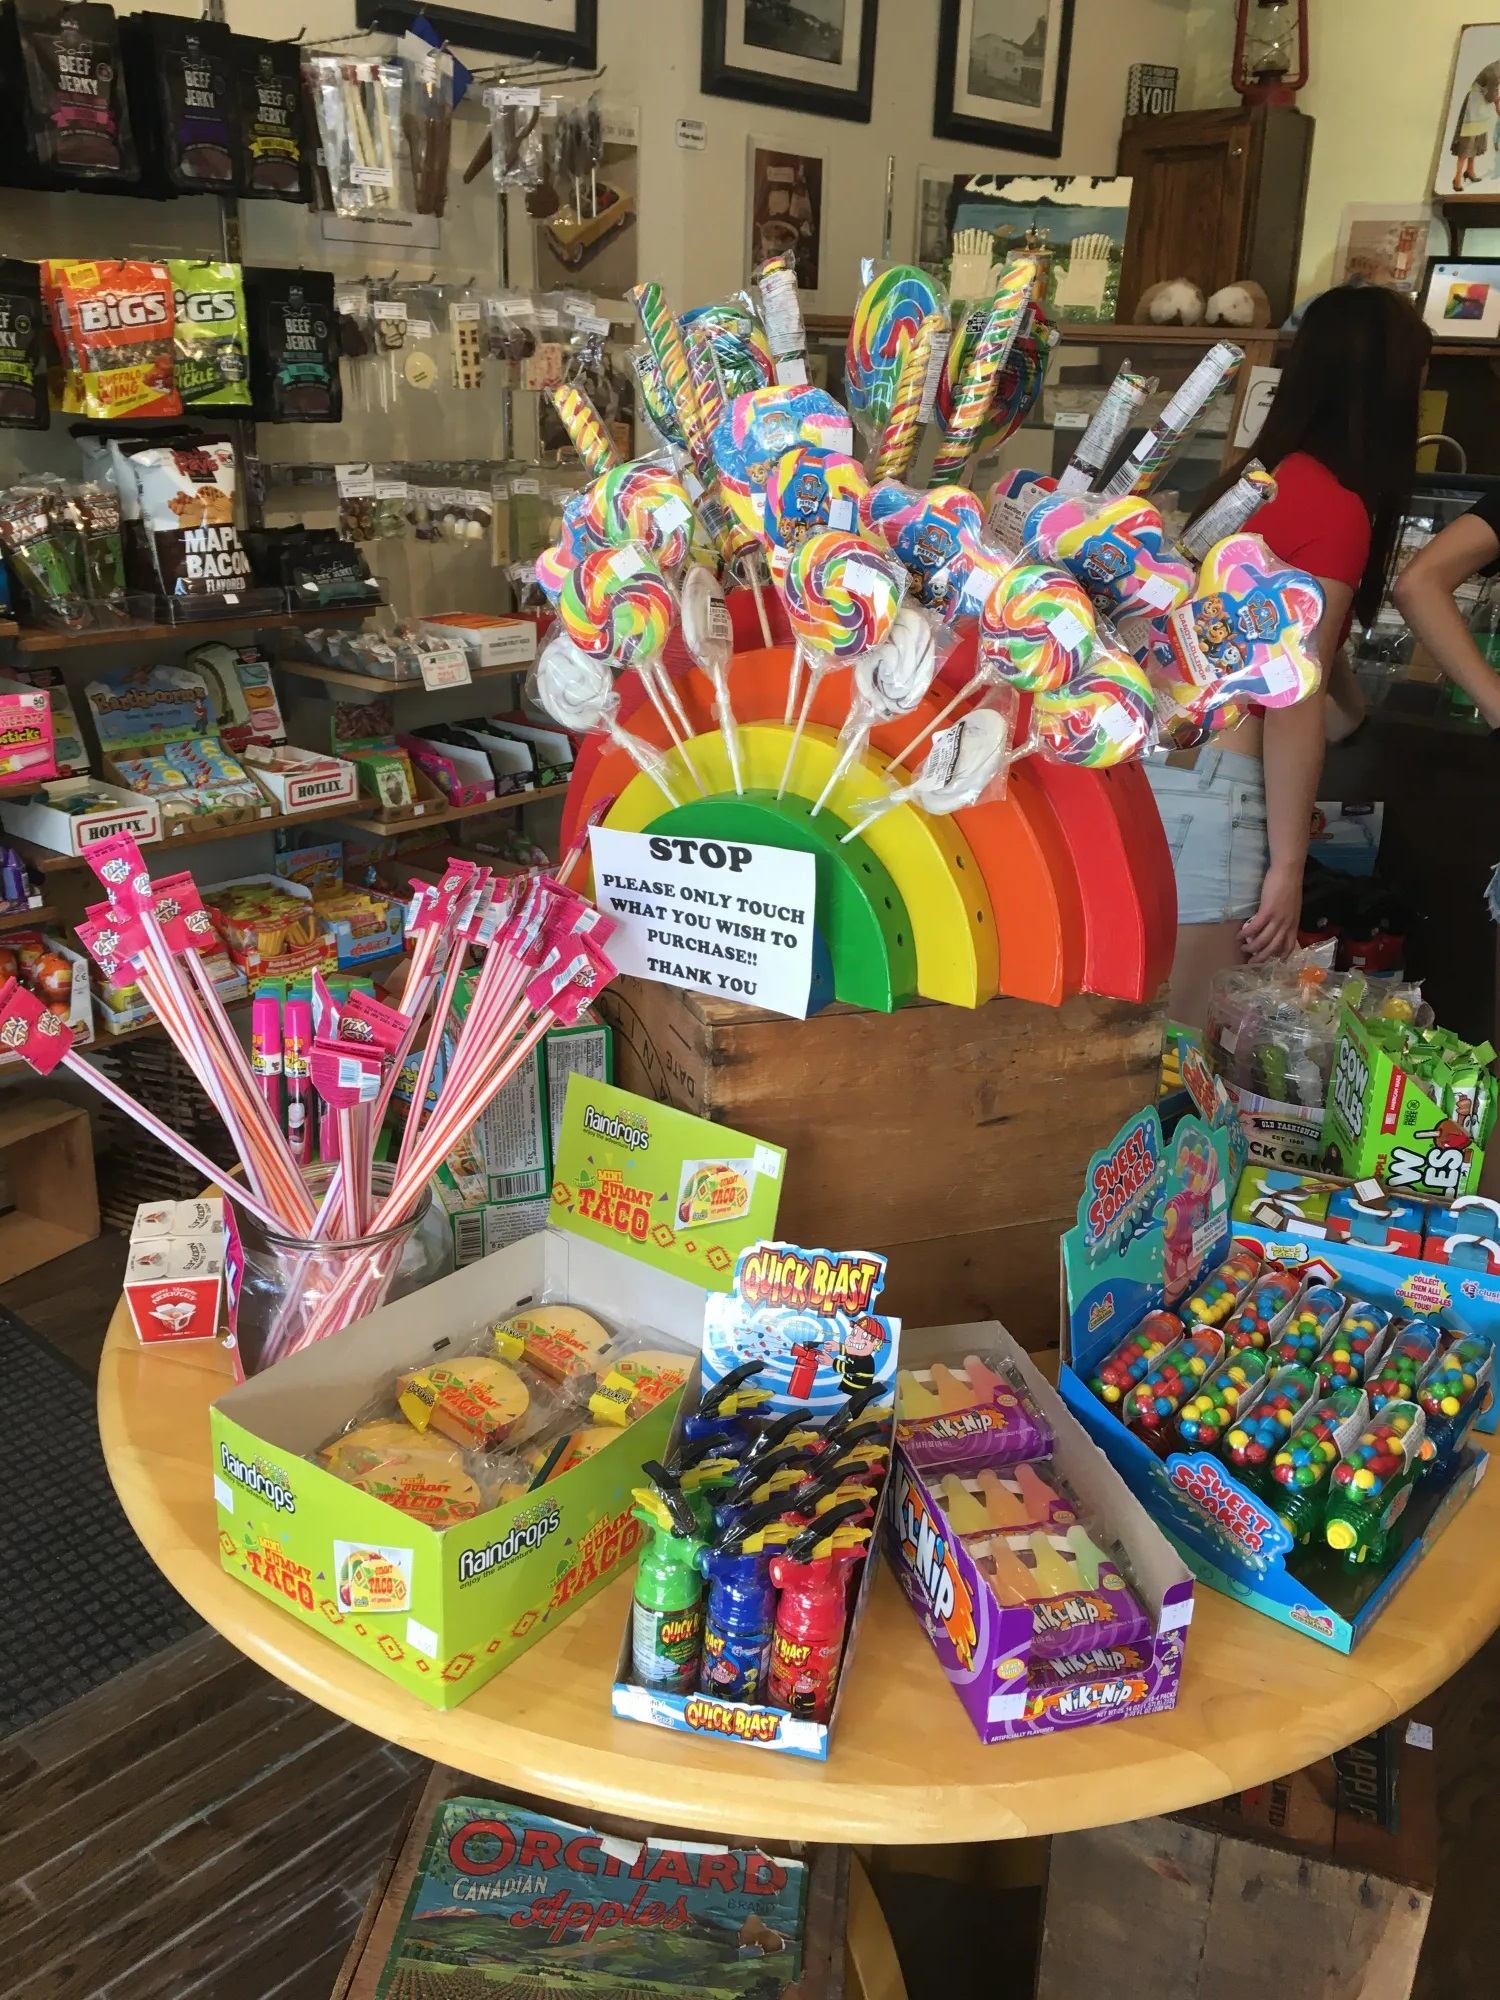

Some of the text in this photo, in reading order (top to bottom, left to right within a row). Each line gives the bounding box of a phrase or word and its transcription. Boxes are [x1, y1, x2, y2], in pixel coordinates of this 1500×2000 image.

[58, 55, 91, 76] BEEF
[57, 75, 98, 96] JERKY
[184, 71, 210, 89] BEEF
[184, 89, 215, 109] JERKY
[258, 88, 283, 106] BEEF
[1142, 87, 1174, 114] YOU
[257, 105, 287, 125] JERKY
[284, 318, 311, 334] BEEF
[284, 334, 317, 351] JERKY
[175, 370, 215, 390] ICKLE
[186, 552, 251, 579] BACON
[206, 577, 246, 594] FLAVORED
[1179, 613, 1207, 681] CANDY LOLLIPOP
[297, 779, 342, 798] HOTLIX
[88, 819, 143, 841] HOTLIX
[649, 837, 753, 873] STOP
[602, 874, 806, 925] PLEASE ONLY TOUCH
[610, 897, 798, 949] WHAT YOU WISH TO
[647, 928, 758, 967] PURCHASE!!
[647, 957, 758, 996] THANK YOU
[1339, 1034, 1369, 1099] COW
[584, 1105, 650, 1151] Raindrops
[1261, 1120, 1275, 1129] OLD
[597, 1169, 624, 1183] MINI
[1093, 1127, 1145, 1198] SWEET
[601, 1181, 654, 1207] GUMMY
[710, 1187, 736, 1206] TACO
[1088, 1151, 1155, 1238] SOAKER
[577, 1188, 651, 1241] TACO
[743, 1250, 879, 1315] QUICK BLAST
[1410, 1283, 1426, 1292] THEM
[1413, 1275, 1440, 1286] COLLECT
[1413, 1301, 1433, 1311] TOUS!
[220, 1441, 296, 1514] Raindrops
[1171, 1465, 1263, 1552] SOAKER
[1196, 1464, 1272, 1535] SWEET
[258, 1536, 282, 1552] MINI
[459, 1509, 561, 1582] Raindrops
[264, 1548, 313, 1582] GUMMY
[459, 1547, 535, 1590] enjoy the adventure
[550, 1517, 642, 1609] TACO
[246, 1551, 315, 1611] TACO
[368, 1577, 393, 1594] TACO
[780, 1638, 812, 1667] BLAST
[686, 1701, 736, 1735] QUICK
[734, 1708, 782, 1741] BLAST
[991, 1731, 1026, 1743] ARTIFICIALLY
[452, 1874, 548, 1903] CANADIAN
[509, 1884, 696, 1945] Apples
